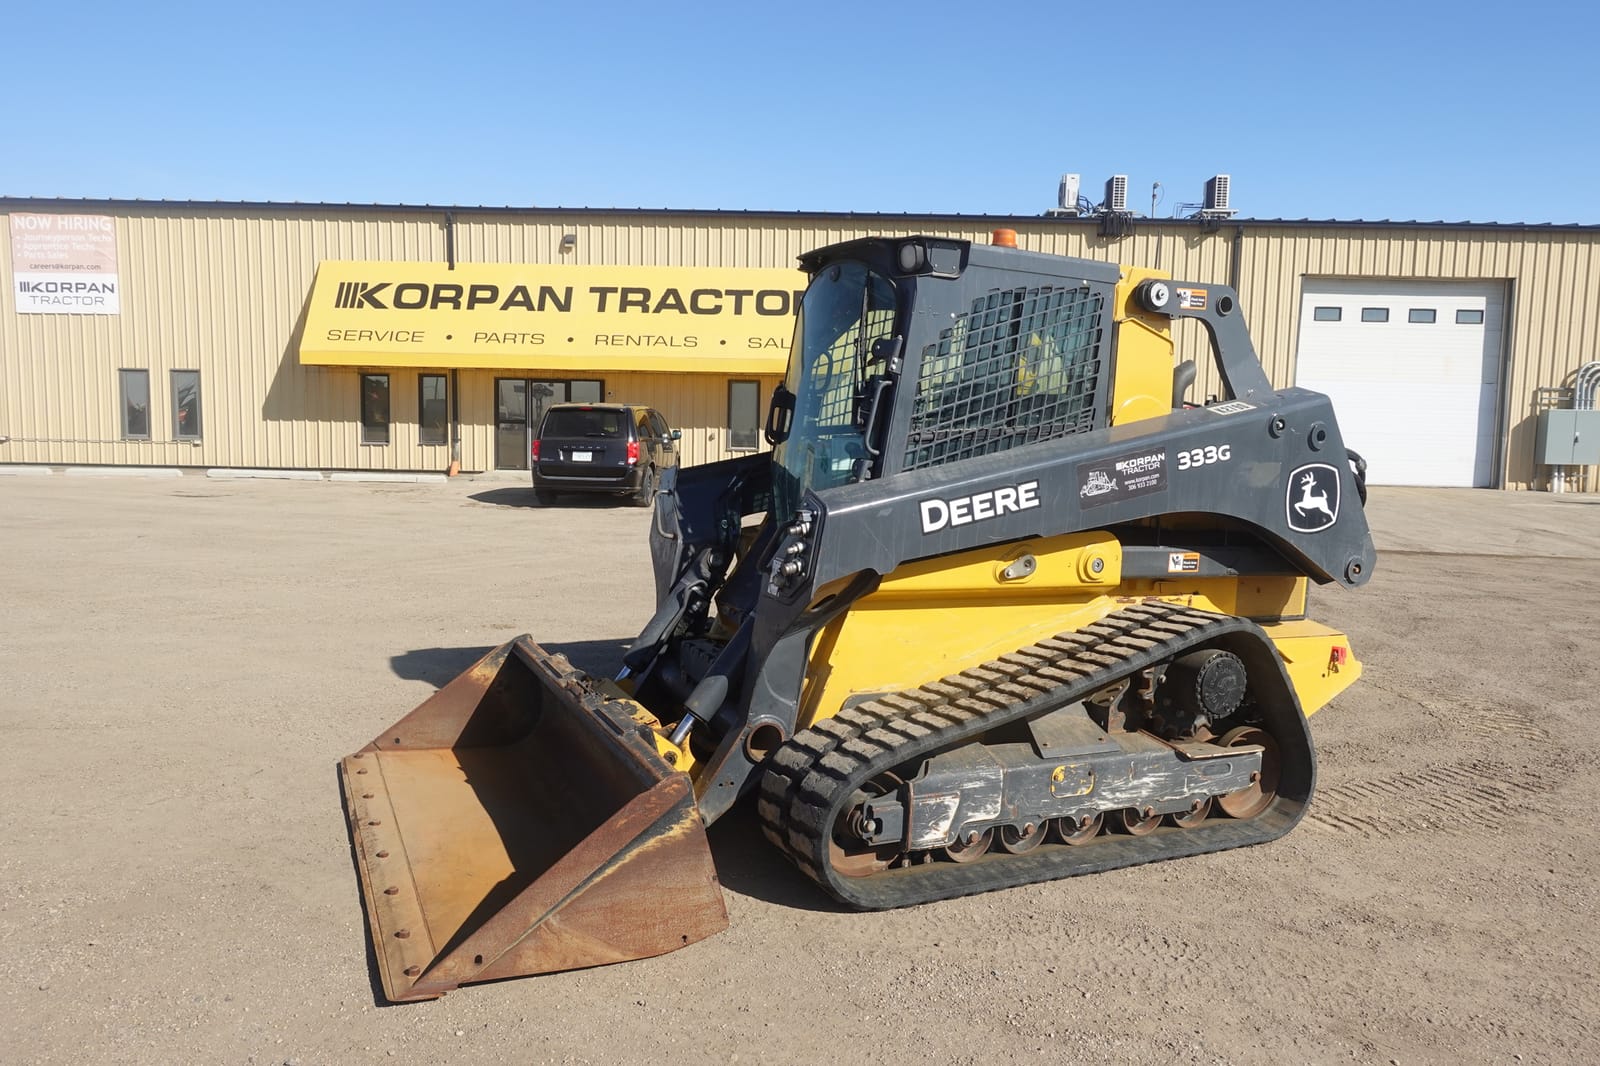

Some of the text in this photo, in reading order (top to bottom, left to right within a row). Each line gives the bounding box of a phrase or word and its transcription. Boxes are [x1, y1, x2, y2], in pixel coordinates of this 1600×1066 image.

[15, 216, 112, 231] NOW HIRING
[31, 282, 115, 293] KORPAN
[29, 296, 105, 305] TRACTOR
[356, 282, 574, 312] KORPAN
[327, 329, 791, 349] SERVICE PARTS RENTALS SAL
[1121, 452, 1165, 469] KORPAN
[1177, 445, 1231, 470] 333G
[1122, 461, 1160, 476] TRACTOR
[920, 481, 1039, 533] DEERE
